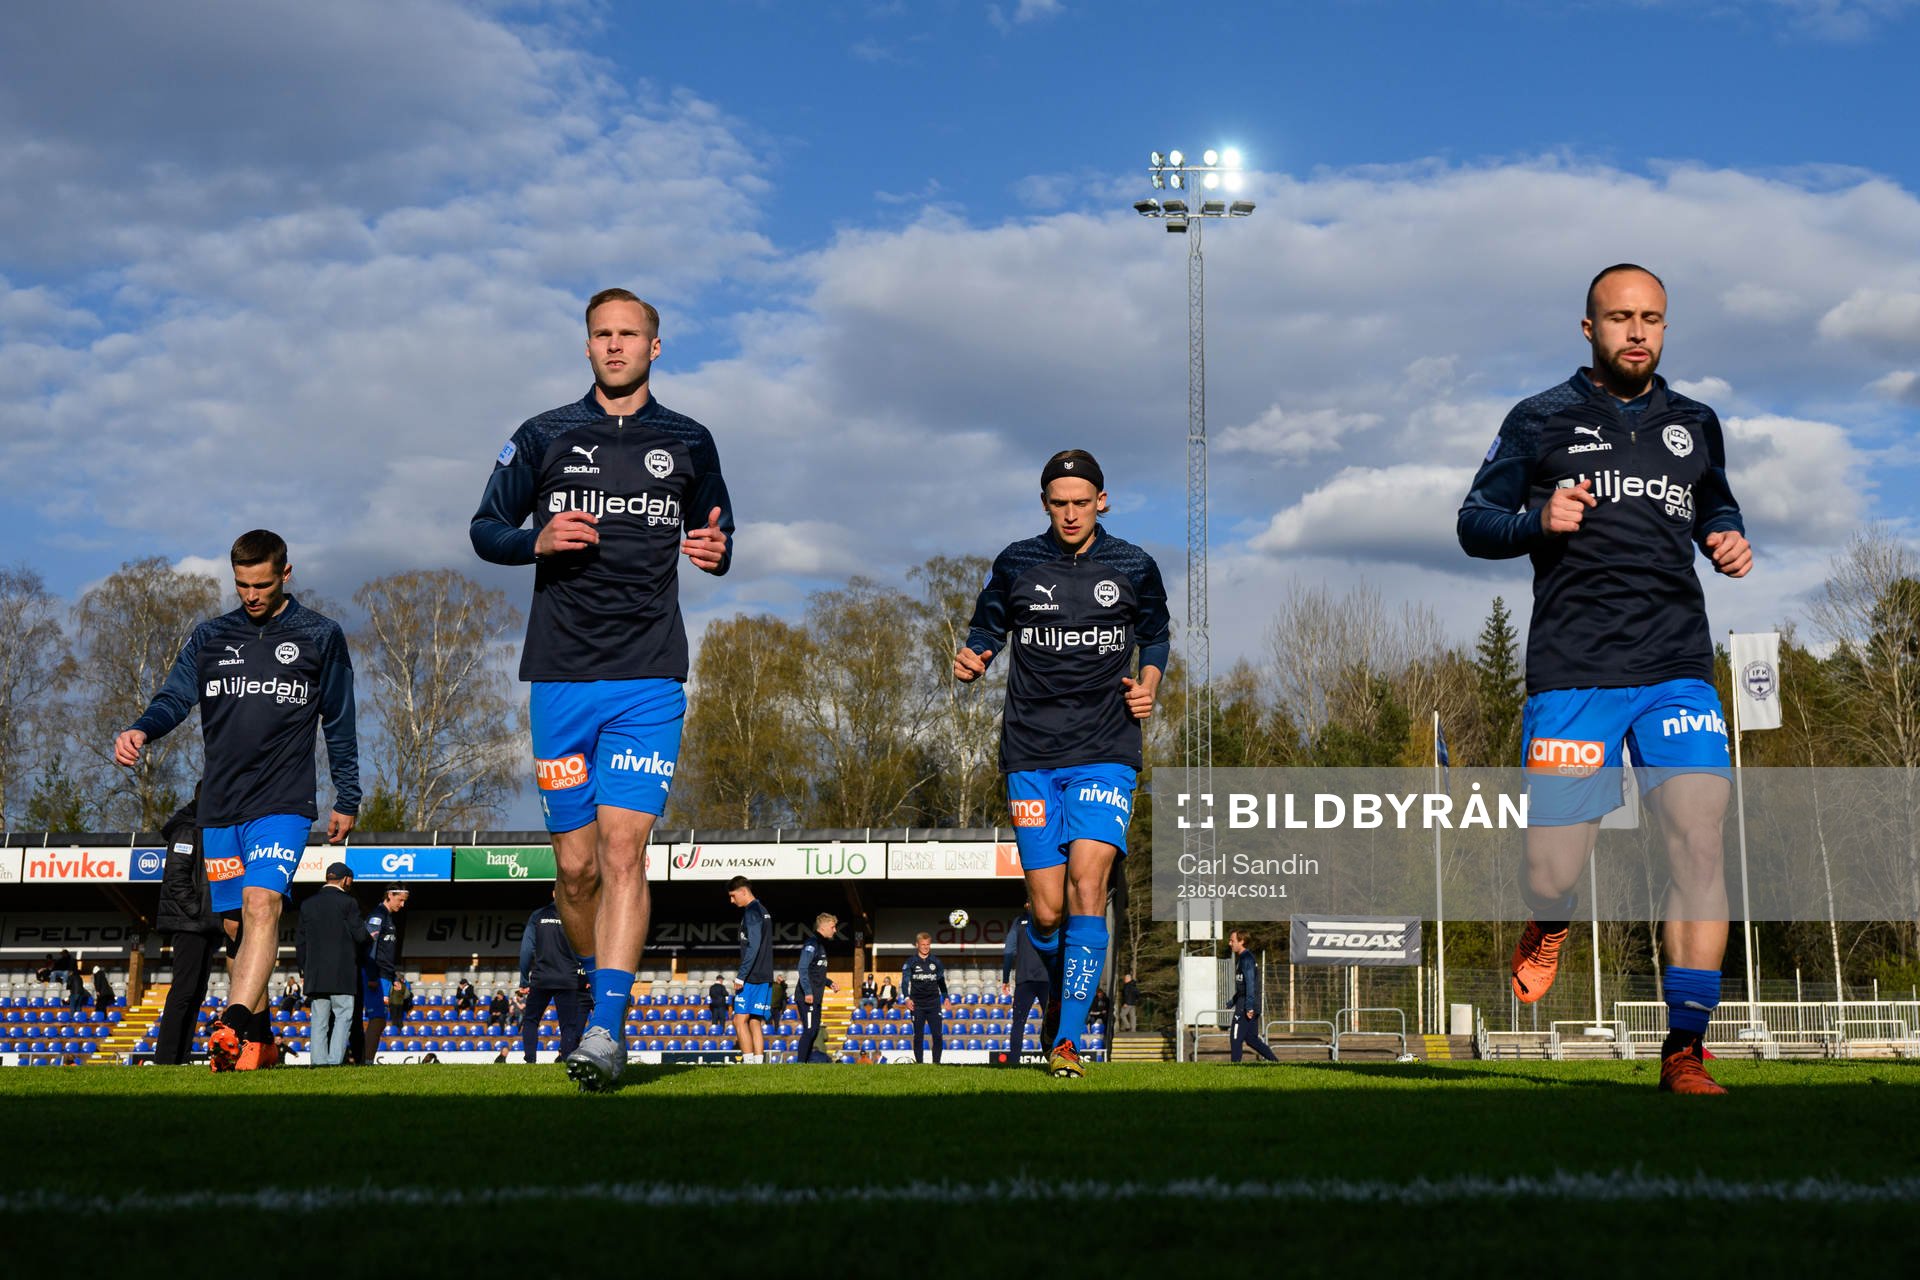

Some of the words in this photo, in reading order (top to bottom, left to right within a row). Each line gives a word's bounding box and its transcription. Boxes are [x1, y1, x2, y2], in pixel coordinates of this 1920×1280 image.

[1568, 442, 1612, 454] stadium
[563, 465, 600, 474] stadium
[647, 515, 680, 528] group
[1029, 603, 1059, 611] stadium
[218, 658, 245, 666] stadium
[276, 695, 308, 706] group
[551, 773, 586, 789] GROUP
[29, 852, 123, 878] nivika.
[141, 858, 157, 869] BW
[486, 851, 519, 868] hang
[701, 858, 723, 867] DIN
[727, 857, 776, 867] MASKIN
[217, 868, 244, 880] GROUP
[508, 862, 529, 878] On
[463, 915, 524, 949] Lilje
[936, 919, 1010, 953] ape
[1307, 932, 1406, 948] TROAX
